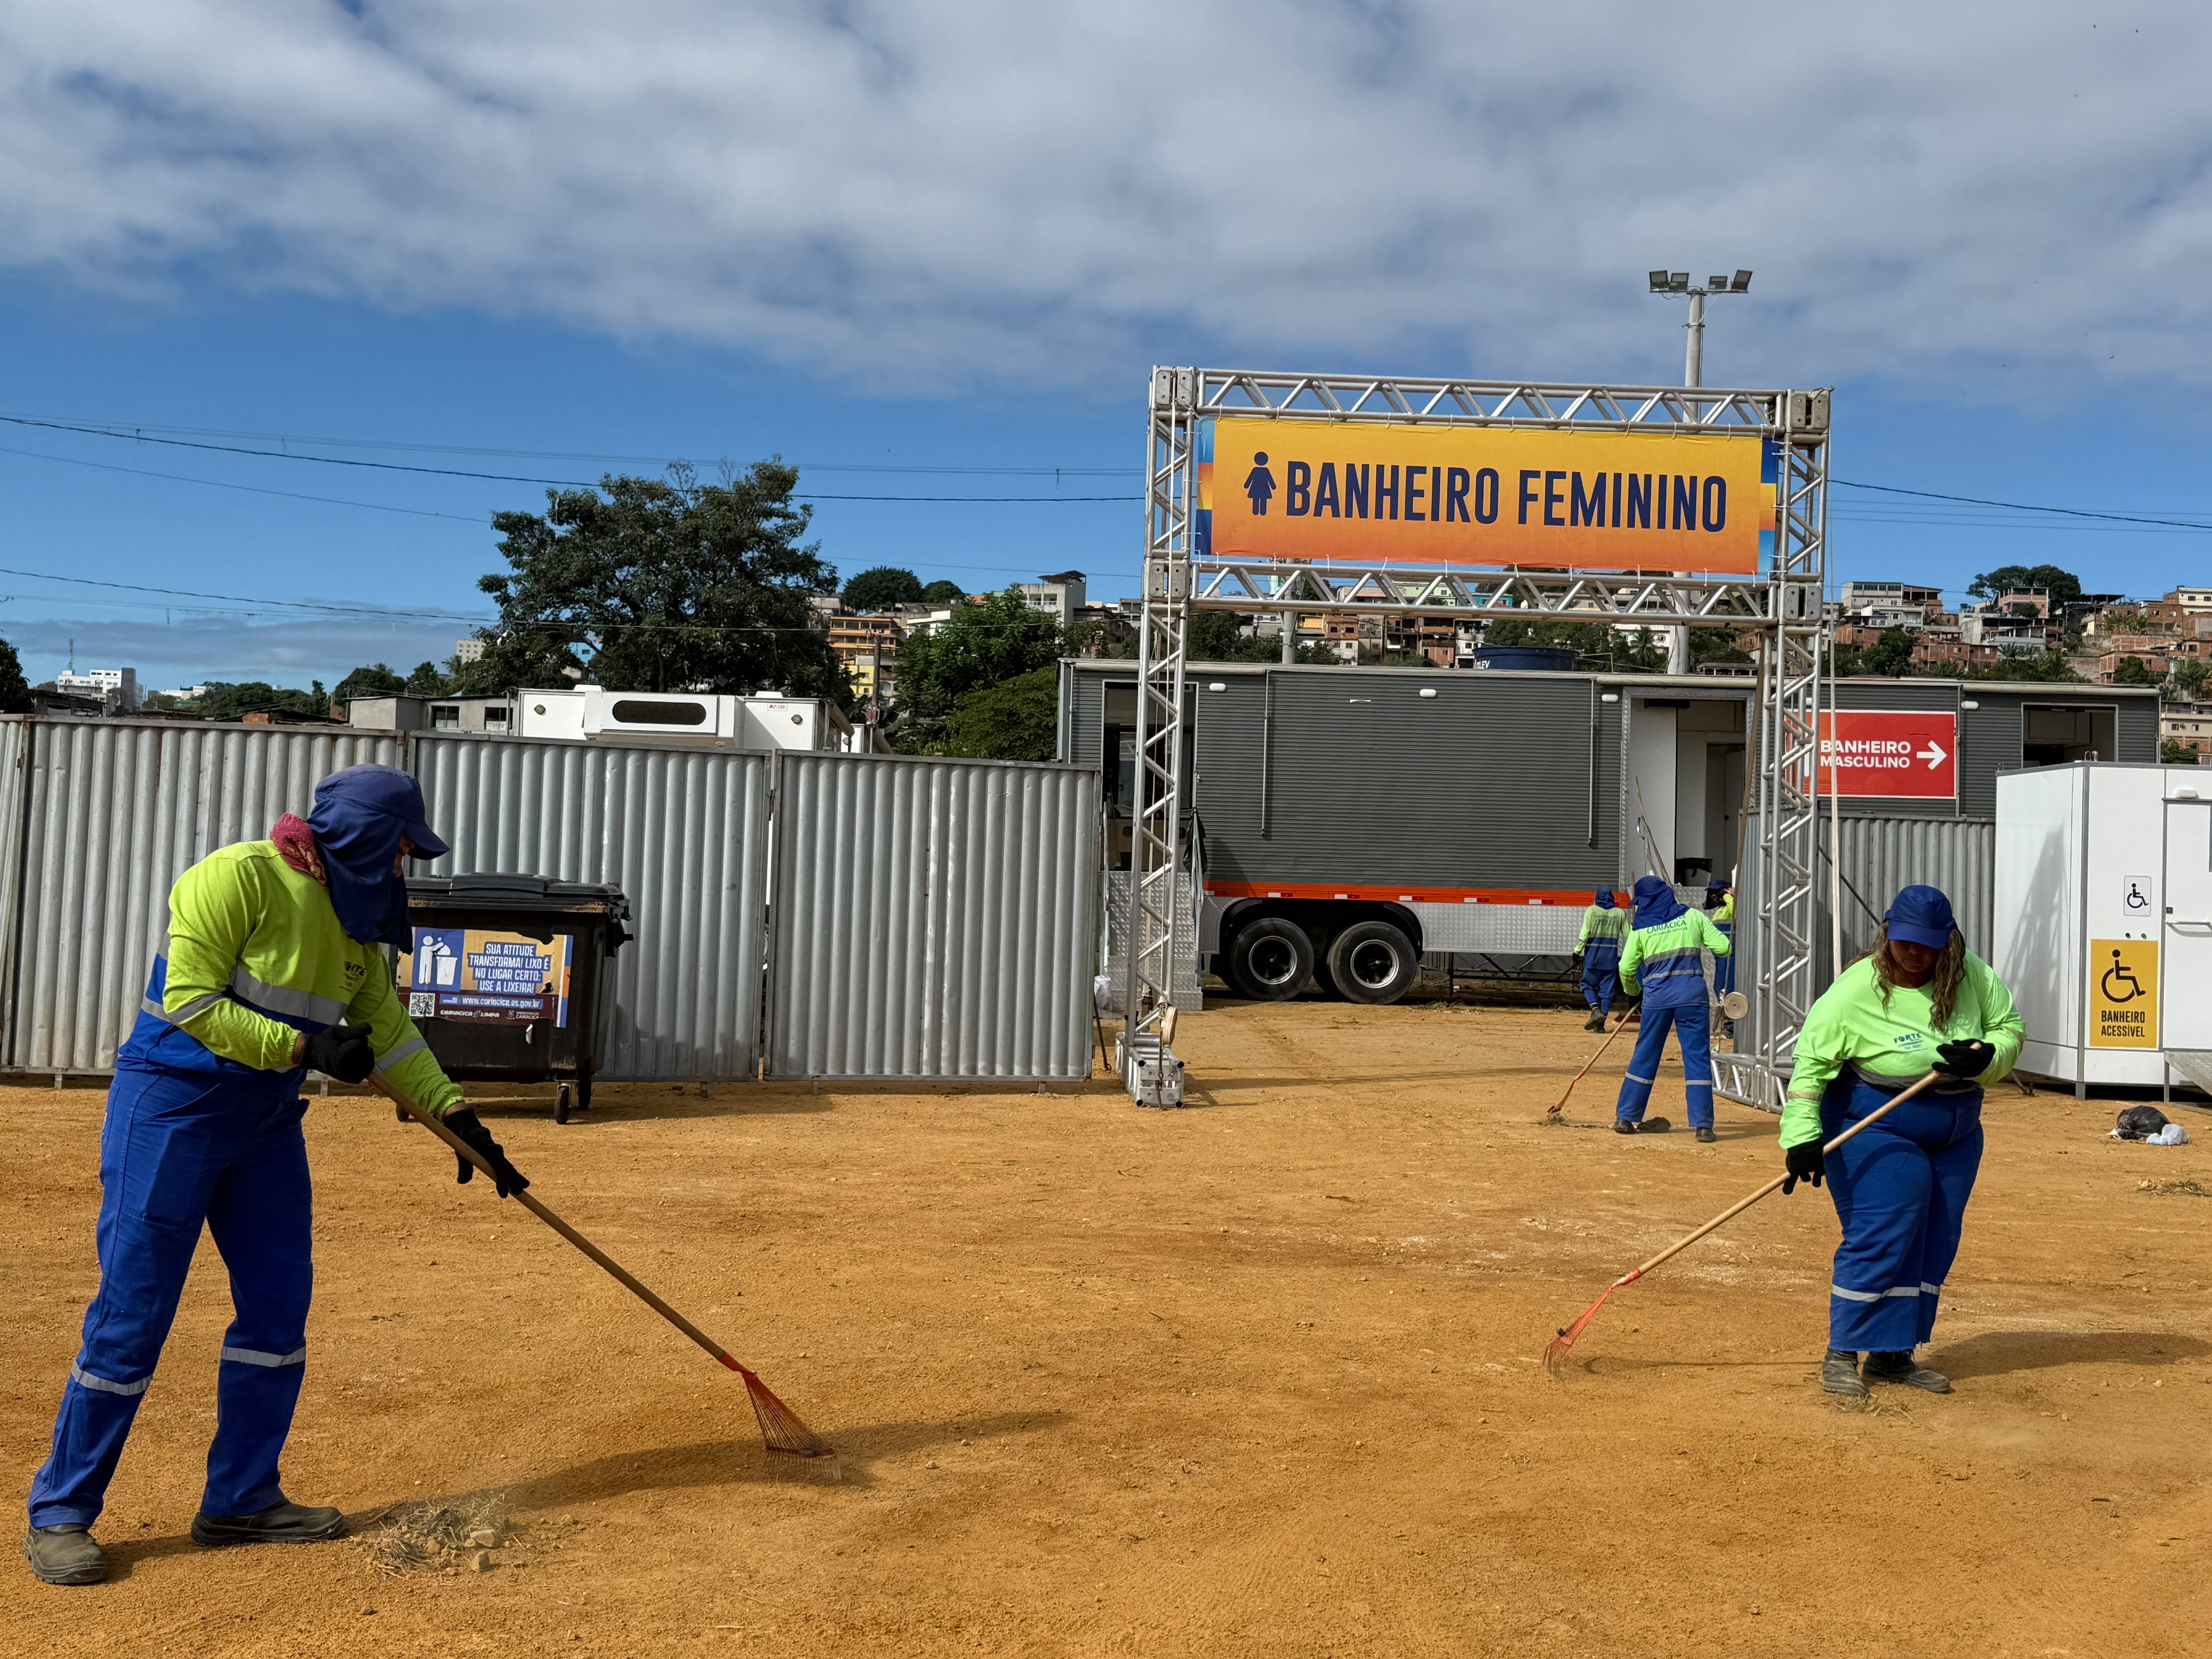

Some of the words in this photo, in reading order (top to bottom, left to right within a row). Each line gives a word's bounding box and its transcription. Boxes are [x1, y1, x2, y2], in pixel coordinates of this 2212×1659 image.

[1286, 460, 1499, 524] BANHEIRO
[1518, 469, 1727, 532] FEMININO
[1821, 740, 1911, 753] BANHEIRO
[1820, 756, 1910, 768] MASCULINO
[486, 943, 501, 954] SUA
[503, 945, 534, 956] ATITUDE
[525, 957, 542, 969] LIXO
[543, 957, 549, 969] É
[475, 967, 486, 978] NO
[488, 968, 513, 980] LUGAR
[515, 970, 541, 981] CERTO:
[480, 980, 495, 991] USE
[496, 981, 501, 992] A
[504, 982, 534, 993] LIXEIRA!
[2101, 1010, 2146, 1023] BANHEIRO
[2101, 1024, 2146, 1037] ACESSÍVEL
[1893, 1033, 1922, 1044] FORTE
